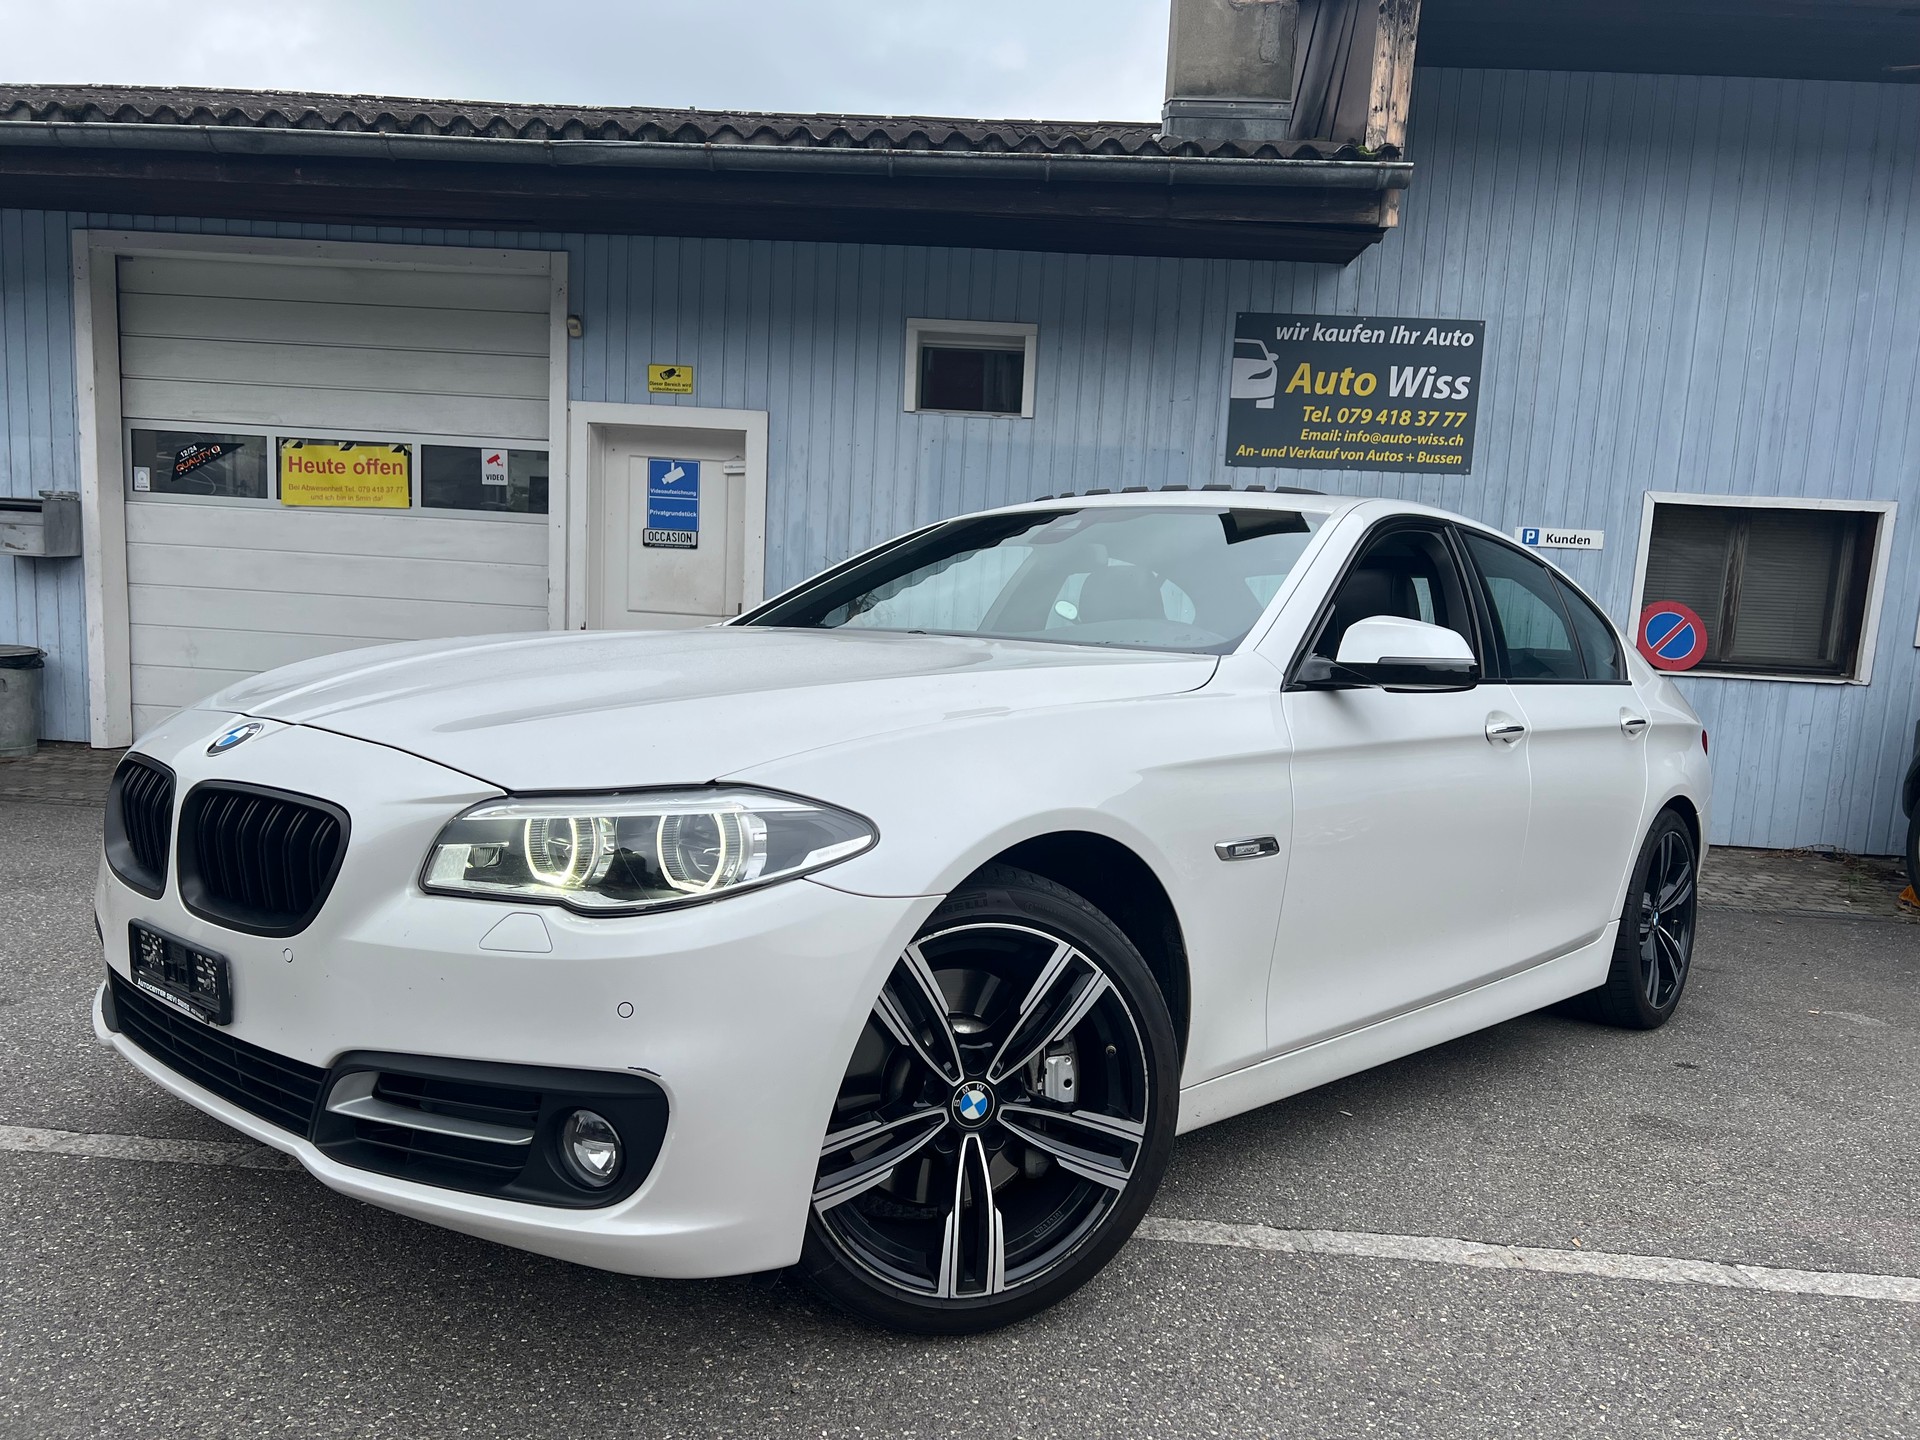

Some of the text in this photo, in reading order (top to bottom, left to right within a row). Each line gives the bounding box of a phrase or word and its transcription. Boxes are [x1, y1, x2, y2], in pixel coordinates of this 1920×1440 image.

[1276, 323, 1475, 347] wir kaufen Ihr Auto
[1285, 363, 1471, 400] Auto Wiss
[1302, 406, 1468, 428] Tel. 079 418 37 77
[1301, 429, 1464, 446] Email: info@auto-wiss.ch
[176, 449, 211, 472] QUALITY
[1236, 444, 1462, 465] An- und Verkauf von Autos + Bussen
[288, 456, 403, 475] Heute offen
[288, 483, 300, 491] Bei
[301, 484, 343, 492] Abwesenheit
[650, 509, 697, 517] Privatgrundstück
[649, 531, 692, 543] OCCASION
[1546, 533, 1591, 545] Kunden
[953, 1083, 985, 1107] BMW
